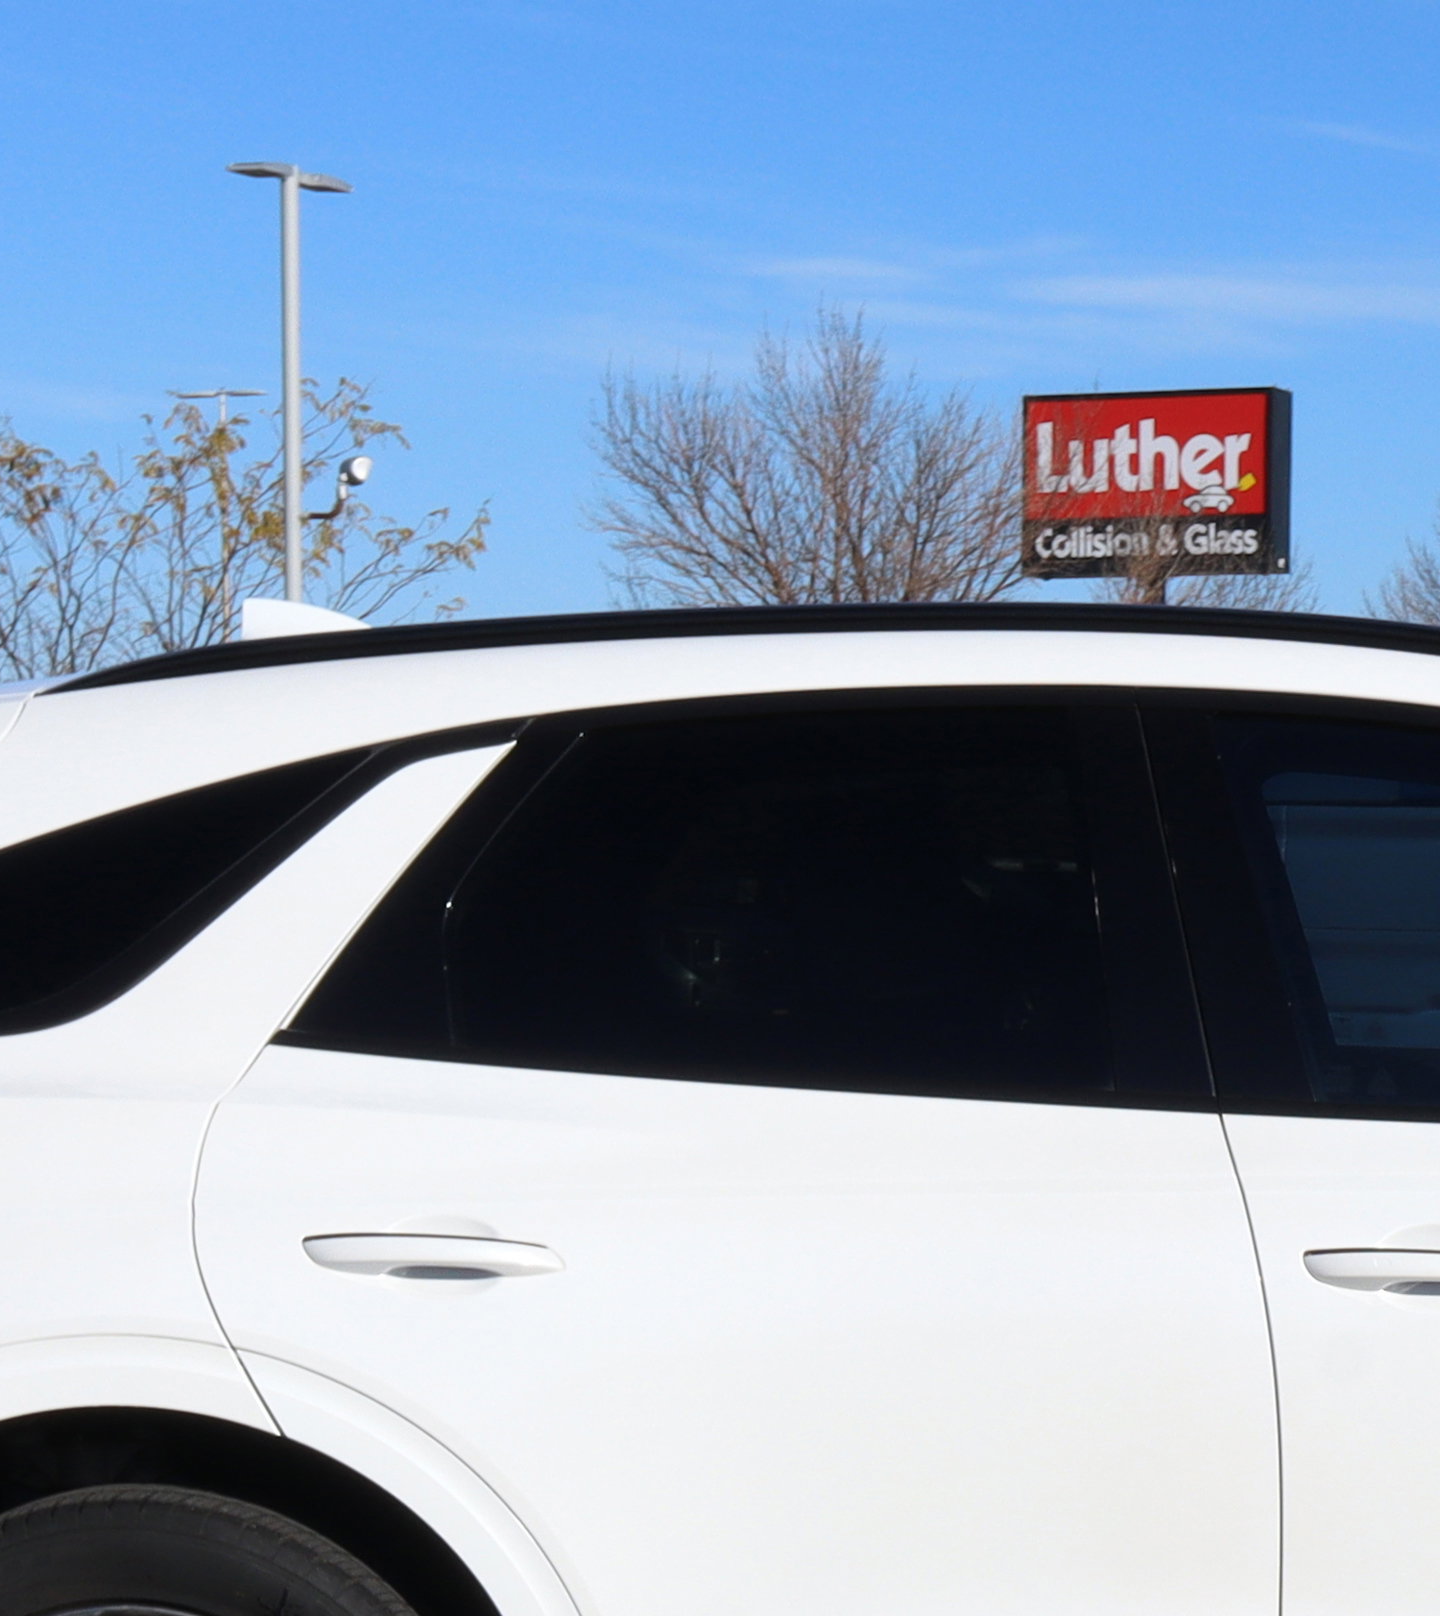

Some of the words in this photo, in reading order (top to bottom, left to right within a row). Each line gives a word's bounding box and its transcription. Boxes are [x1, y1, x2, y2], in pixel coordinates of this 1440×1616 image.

[1035, 417, 1252, 493] Luther
[1034, 523, 1150, 560] Collision
[1155, 522, 1179, 557] &
[1183, 522, 1260, 556] Glass
